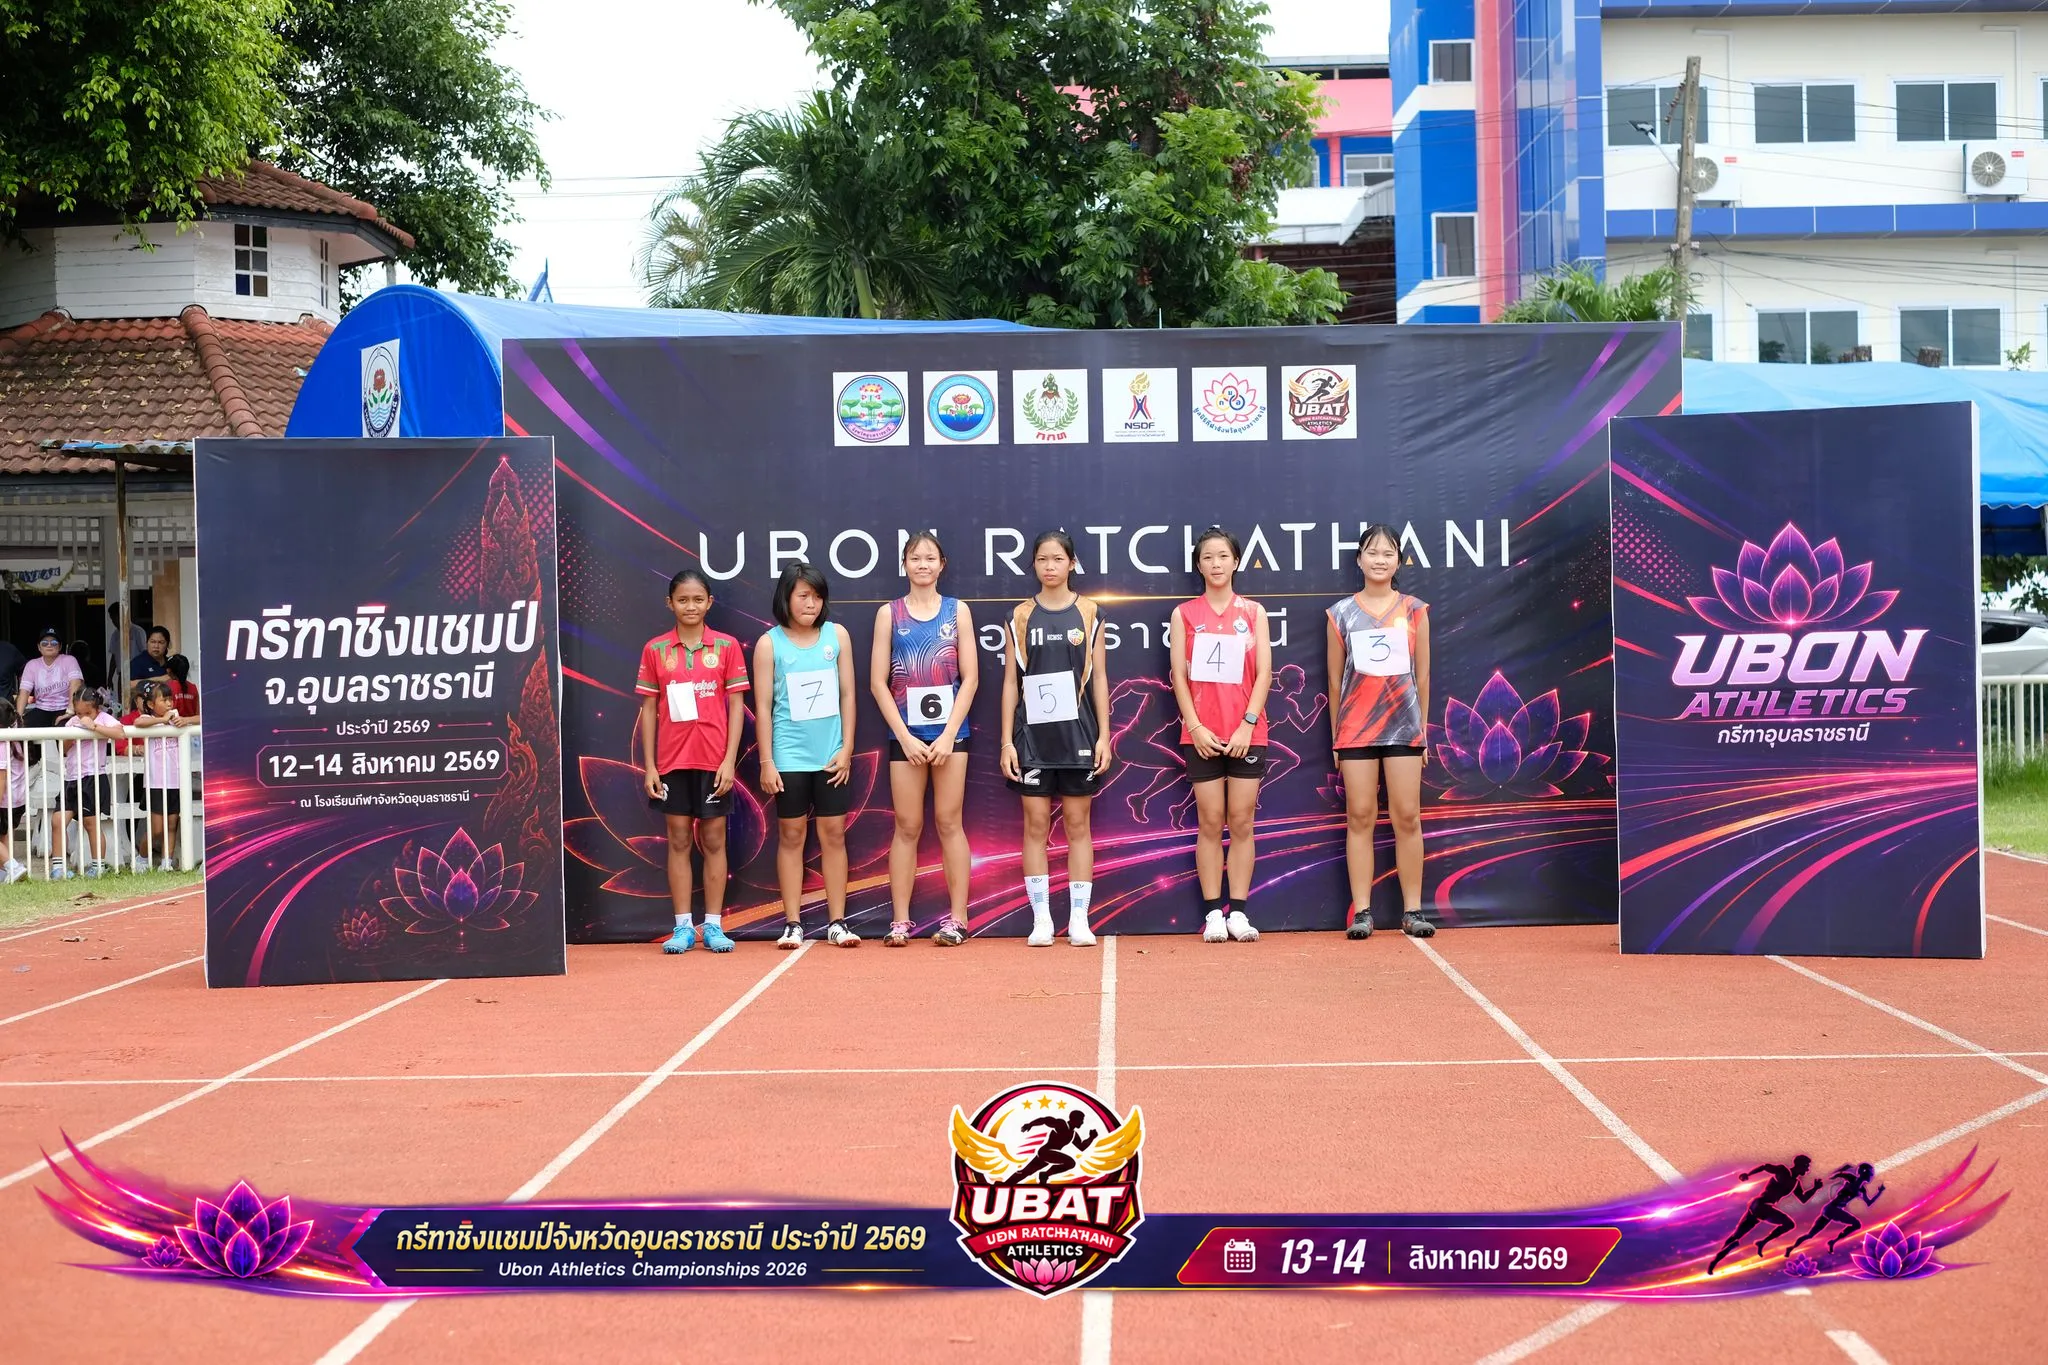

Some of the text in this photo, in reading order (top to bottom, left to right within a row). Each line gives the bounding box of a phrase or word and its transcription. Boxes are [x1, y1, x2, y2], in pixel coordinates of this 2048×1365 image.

[1294, 402, 1346, 416] UBAT
[1124, 422, 1155, 430] NSDF
[226, 600, 539, 661] กรีฑาชิงแชมป์
[1030, 628, 1043, 646] 11
[1207, 641, 1226, 673] 4
[1369, 635, 1391, 662] 3
[1671, 630, 1930, 686] UBON
[265, 661, 496, 715] จ.อุบลราชธานี
[801, 680, 824, 713] 7
[1038, 683, 1057, 714] 5
[920, 693, 943, 719] 6
[1673, 688, 1924, 720] ATHLETICS
[336, 718, 431, 736] ประจำปี 2569
[1717, 722, 1871, 748] กรีฑาอุบลราชธานี
[352, 752, 436, 775] สิงหาคม
[444, 749, 501, 772] 2569
[300, 789, 470, 808] ณ โรงเรียนกีฬาจังหวัดอุบลราชธานี
